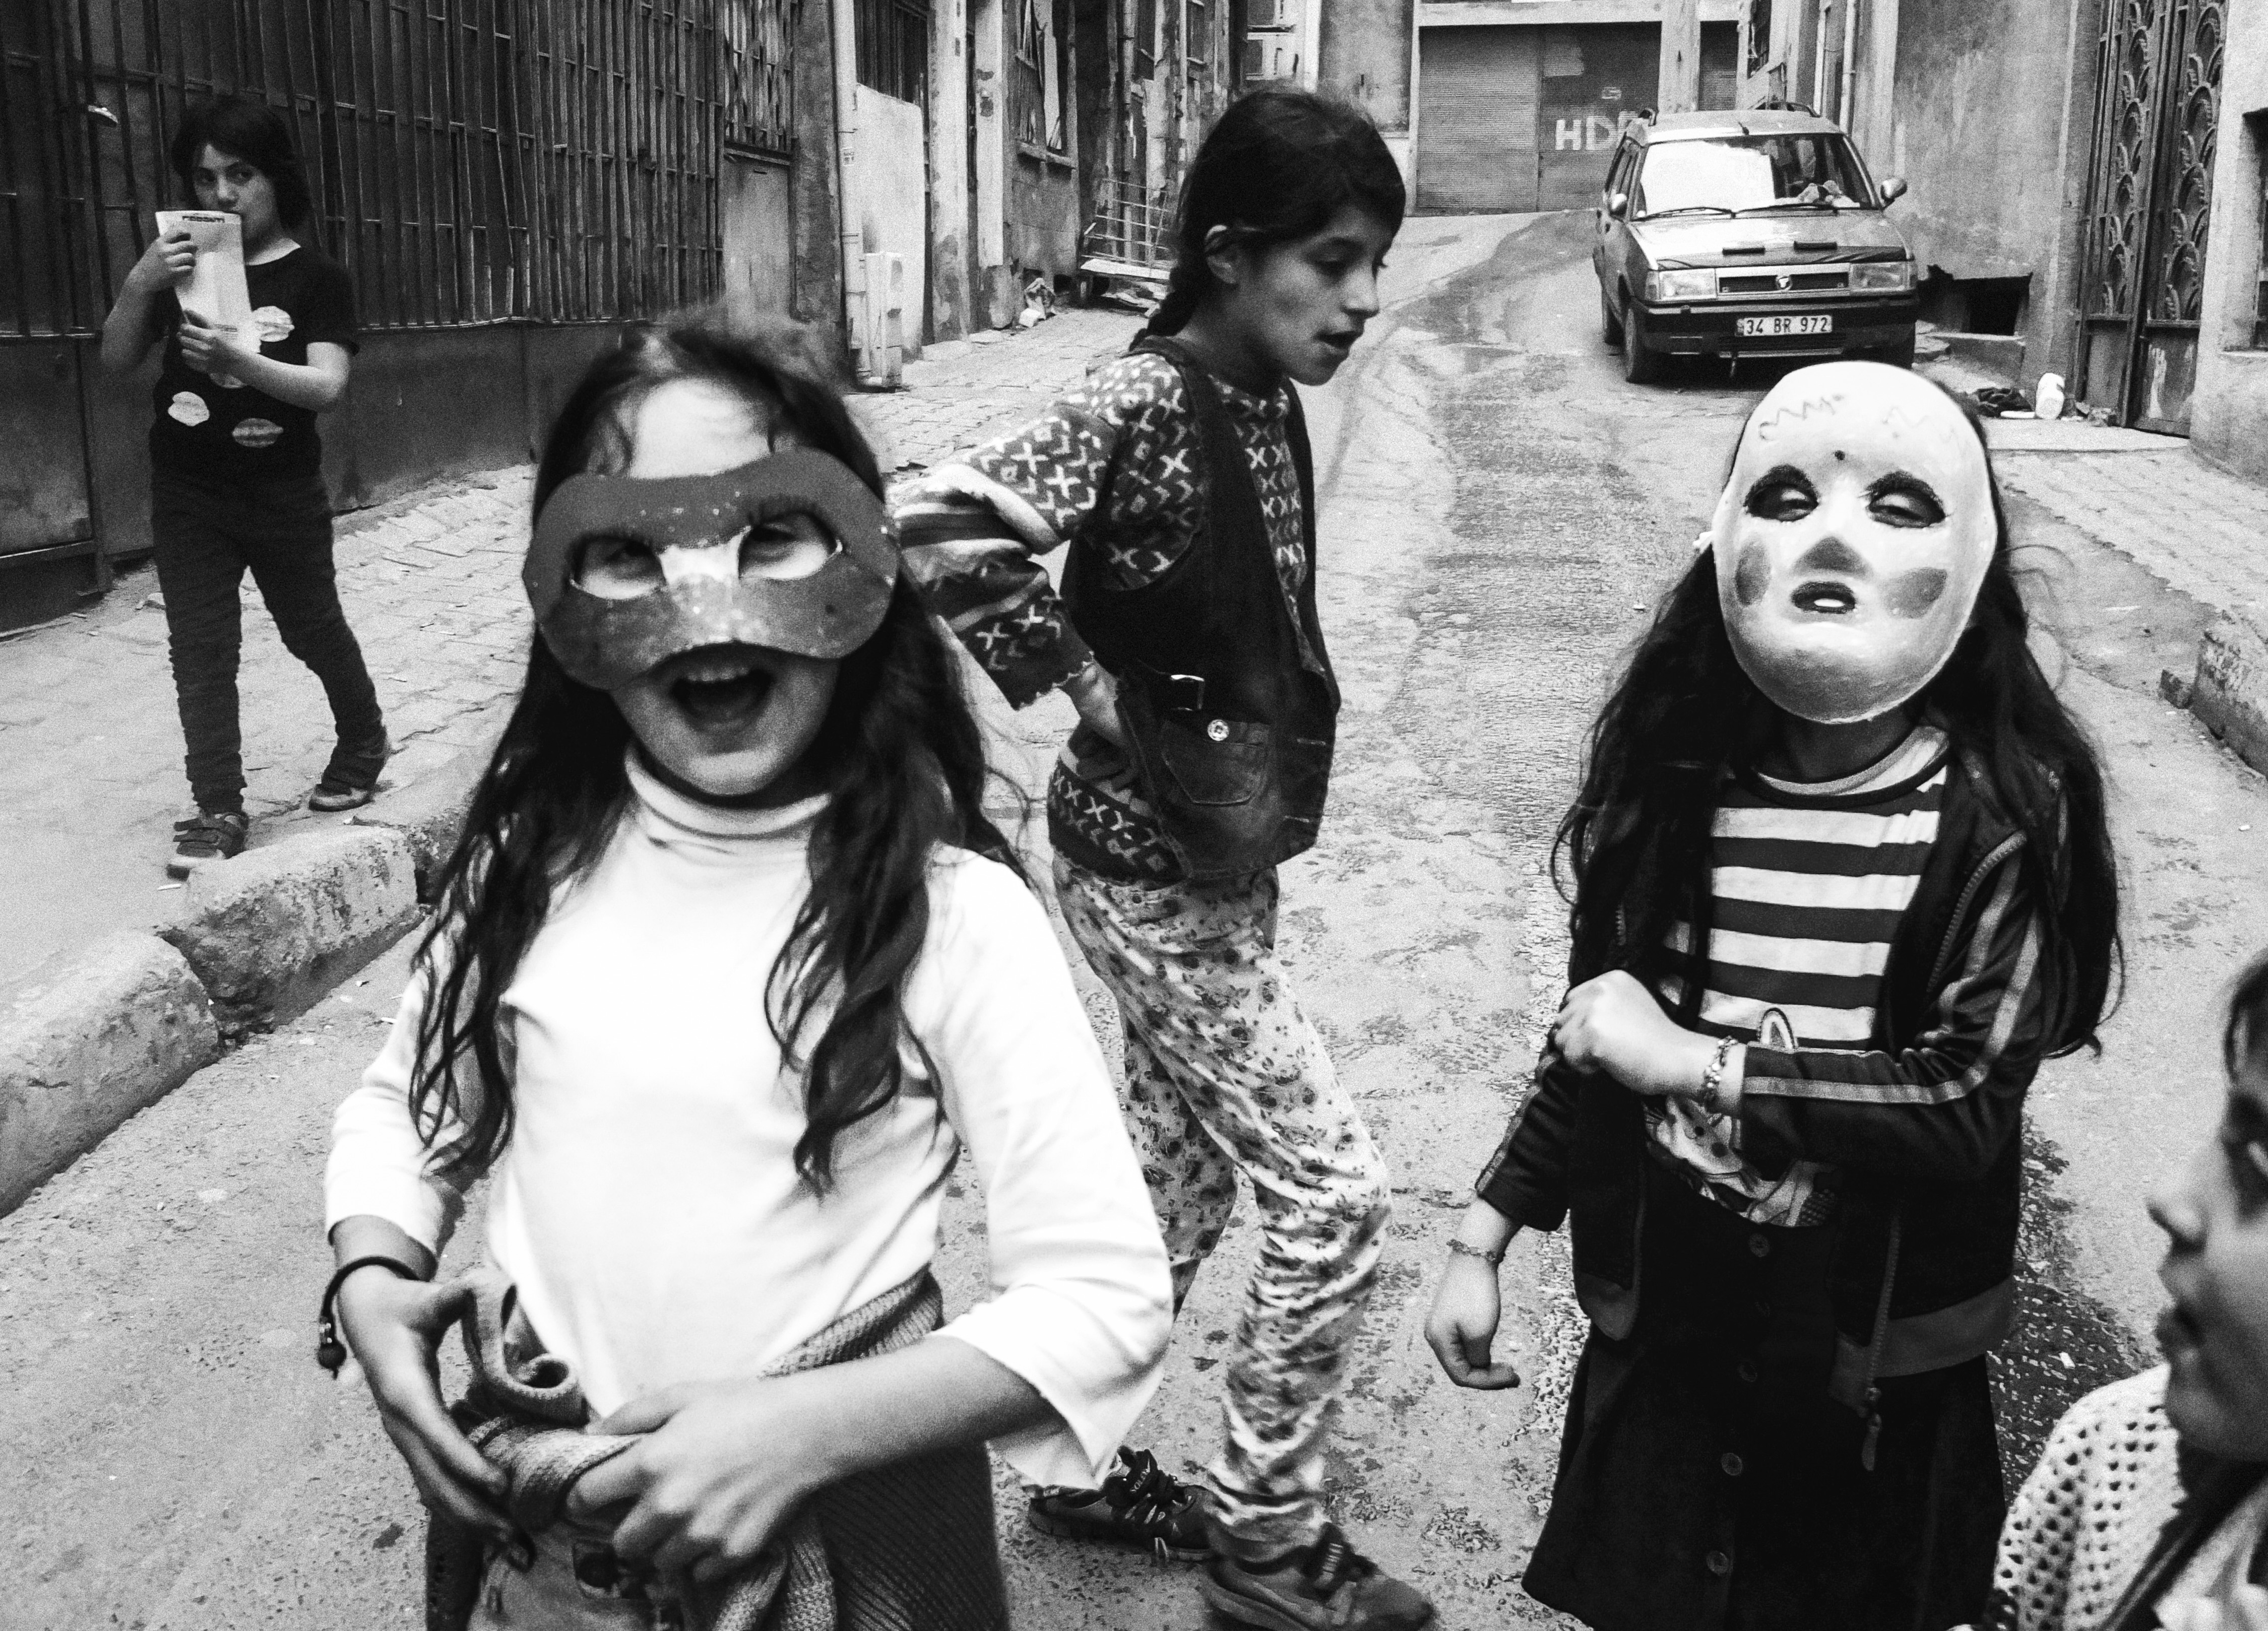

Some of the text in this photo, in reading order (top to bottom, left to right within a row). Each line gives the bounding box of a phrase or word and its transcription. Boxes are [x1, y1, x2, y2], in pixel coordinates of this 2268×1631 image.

[1746, 316, 1828, 334] 34 BR 972
